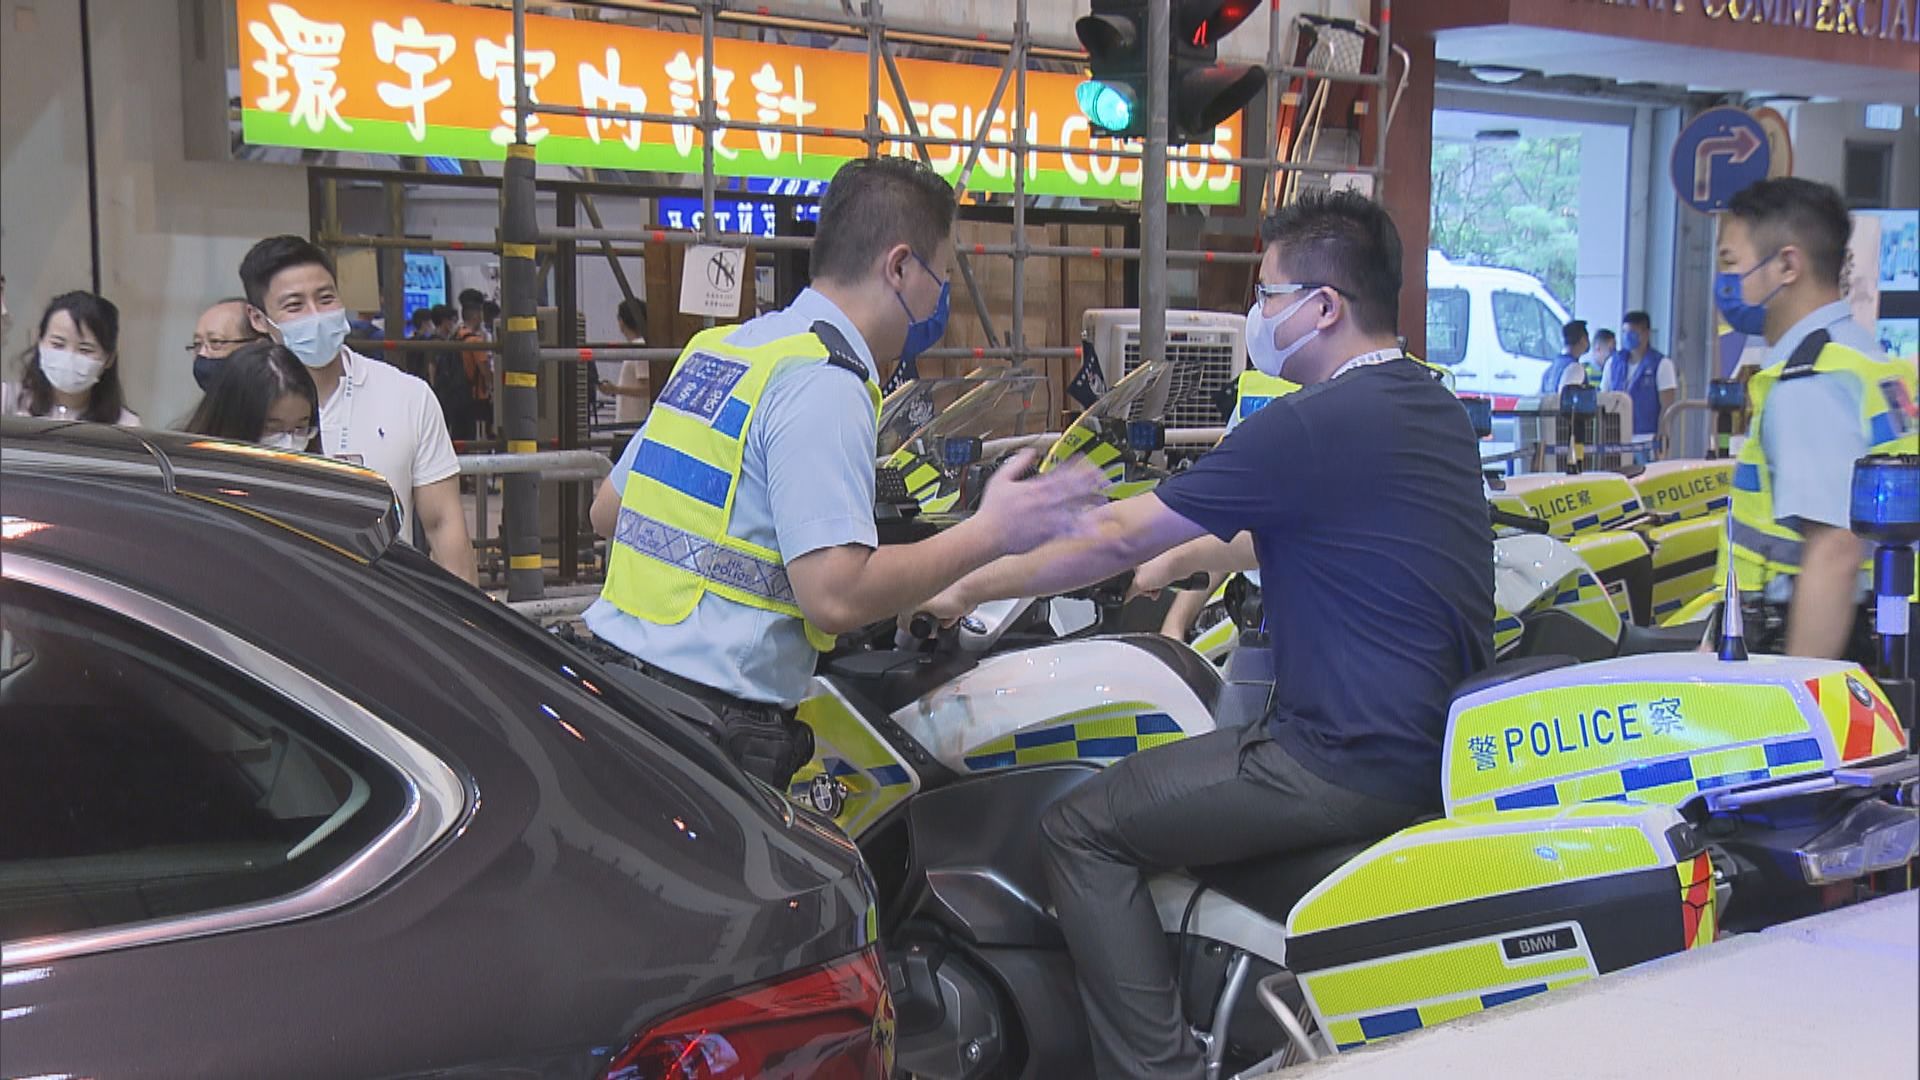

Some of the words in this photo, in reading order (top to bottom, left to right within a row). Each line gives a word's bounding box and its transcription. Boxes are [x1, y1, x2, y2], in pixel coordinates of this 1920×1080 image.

[1657, 475, 1716, 506] POLICE
[1530, 493, 1579, 520] OLICE
[1468, 734, 1498, 771] 警
[1504, 703, 1642, 764] POLICE
[1649, 697, 1684, 736] 察
[1518, 933, 1557, 954] BMW
